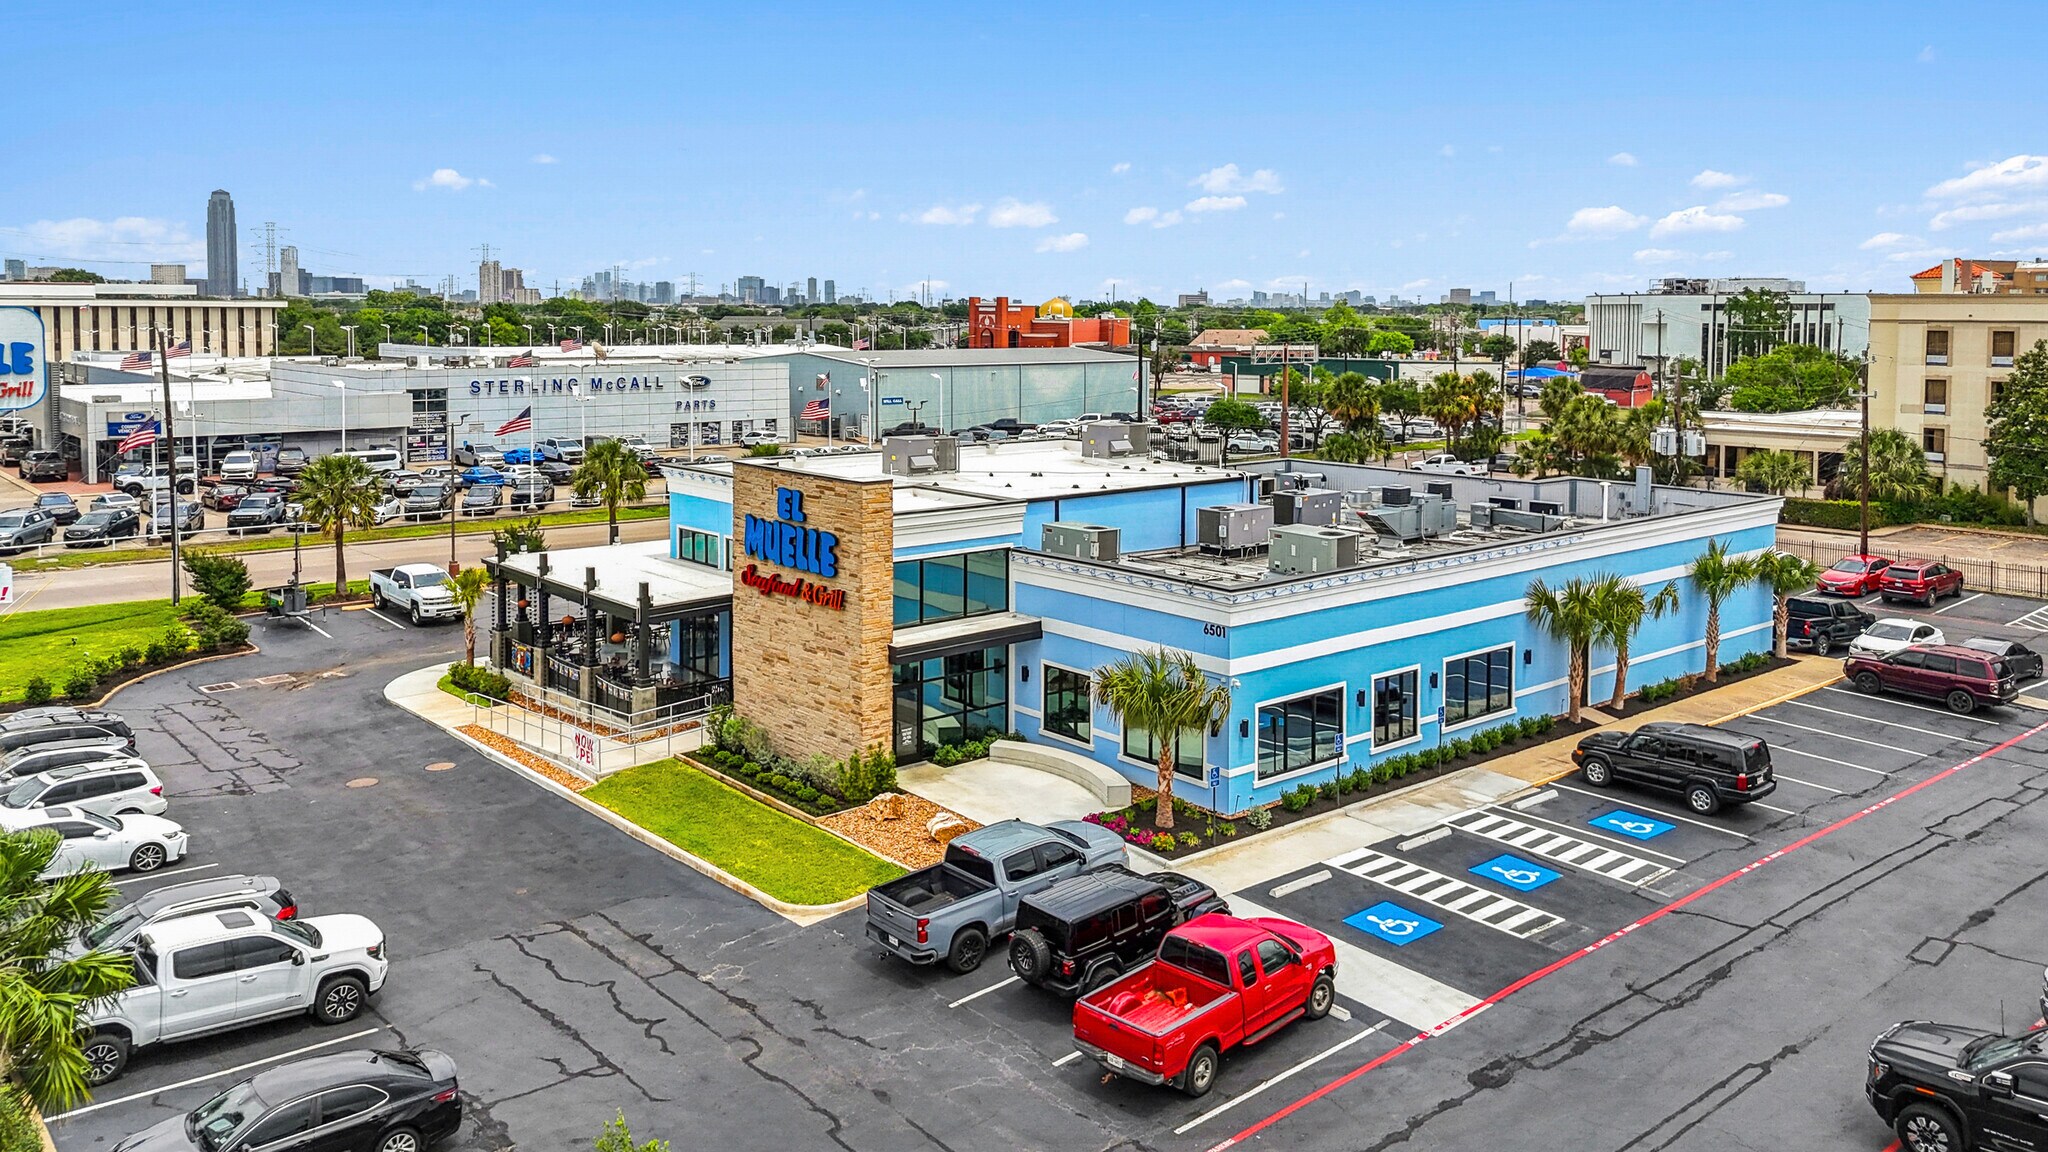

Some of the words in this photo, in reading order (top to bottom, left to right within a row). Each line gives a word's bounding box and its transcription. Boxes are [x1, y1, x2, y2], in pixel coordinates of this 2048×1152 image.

[470, 378, 579, 395] STERLING
[591, 376, 664, 391] McCALL
[676, 400, 716, 410] PARTS
[777, 487, 807, 523] EL
[744, 513, 839, 578] MUELLE
[741, 564, 804, 598] Seafood
[801, 582, 815, 603] &
[813, 585, 846, 612] Grill
[1203, 622, 1226, 639] 6501
[574, 732, 594, 751] NOW
